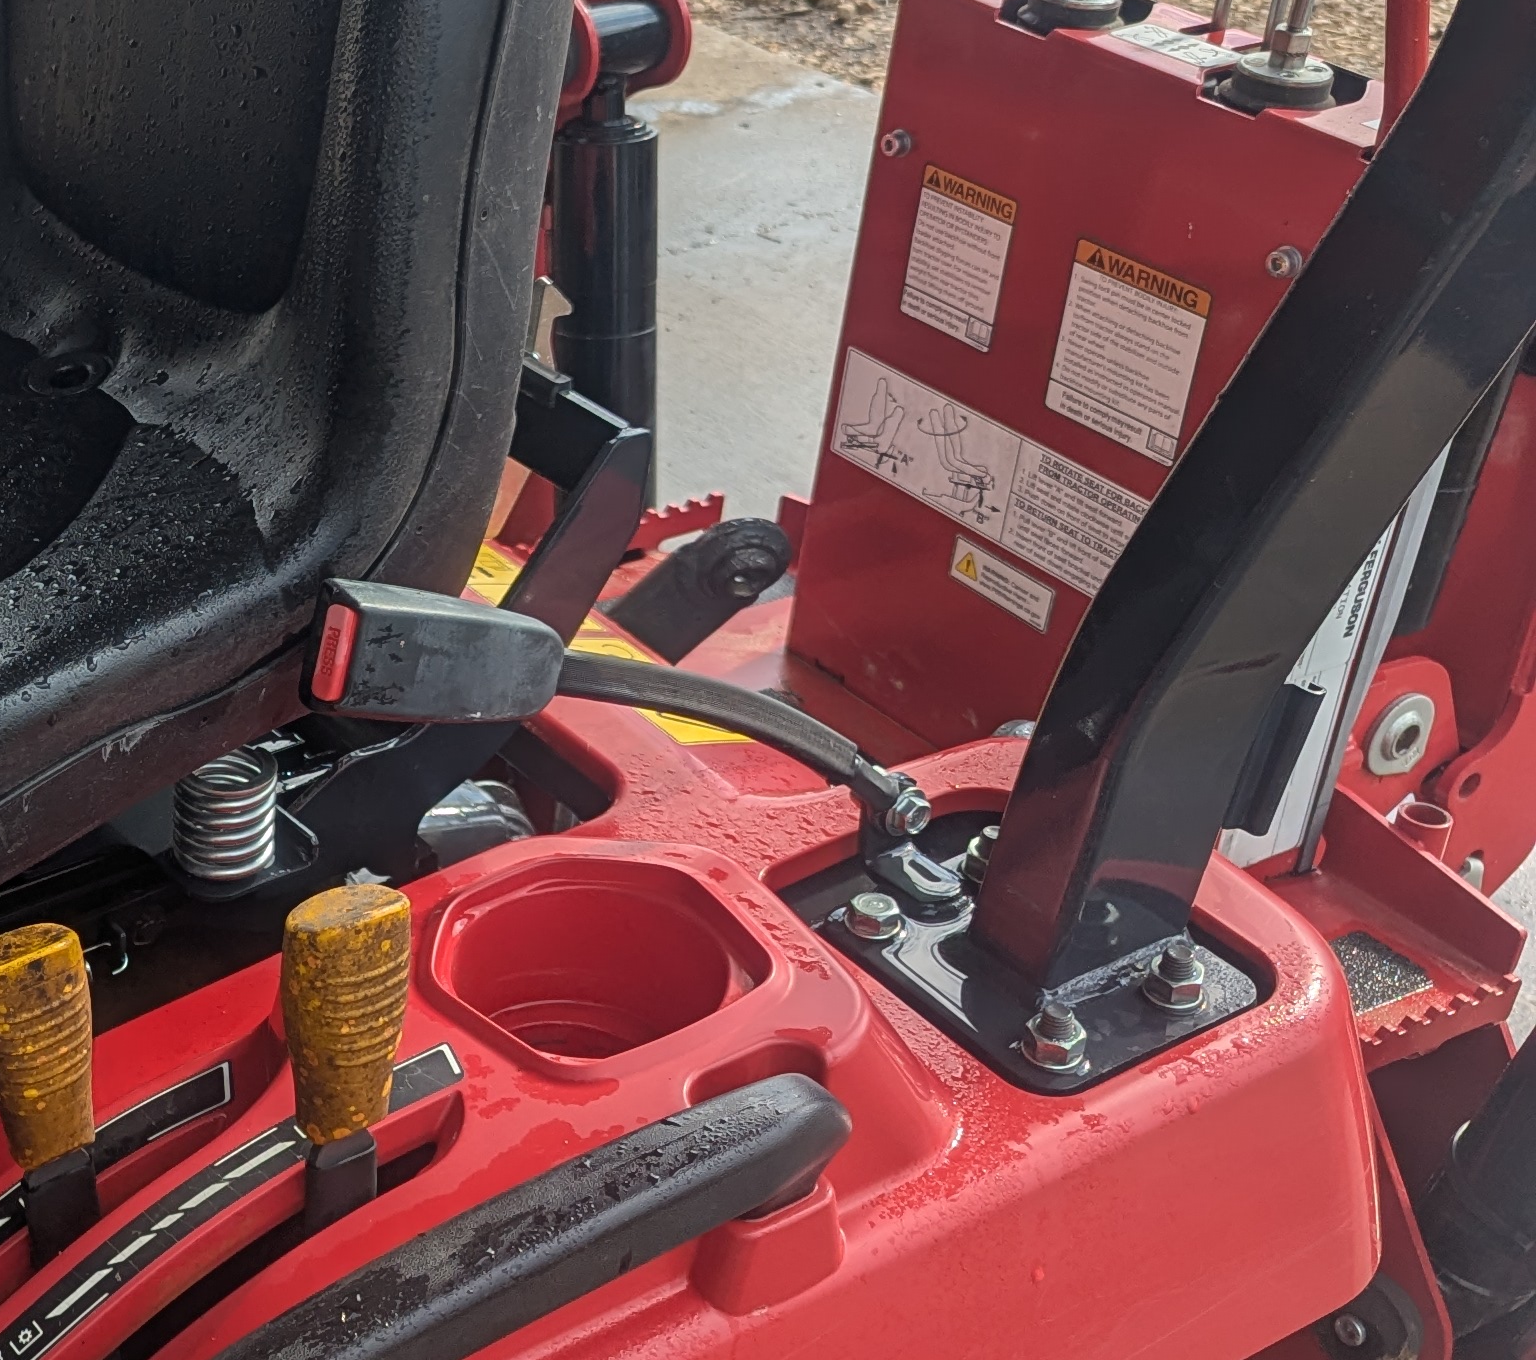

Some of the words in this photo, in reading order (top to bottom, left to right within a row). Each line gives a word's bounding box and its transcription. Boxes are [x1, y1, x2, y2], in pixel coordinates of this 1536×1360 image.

[943, 176, 1012, 219] WARNING
[1108, 256, 1198, 308] WARNING
[320, 625, 341, 677] PRESS
